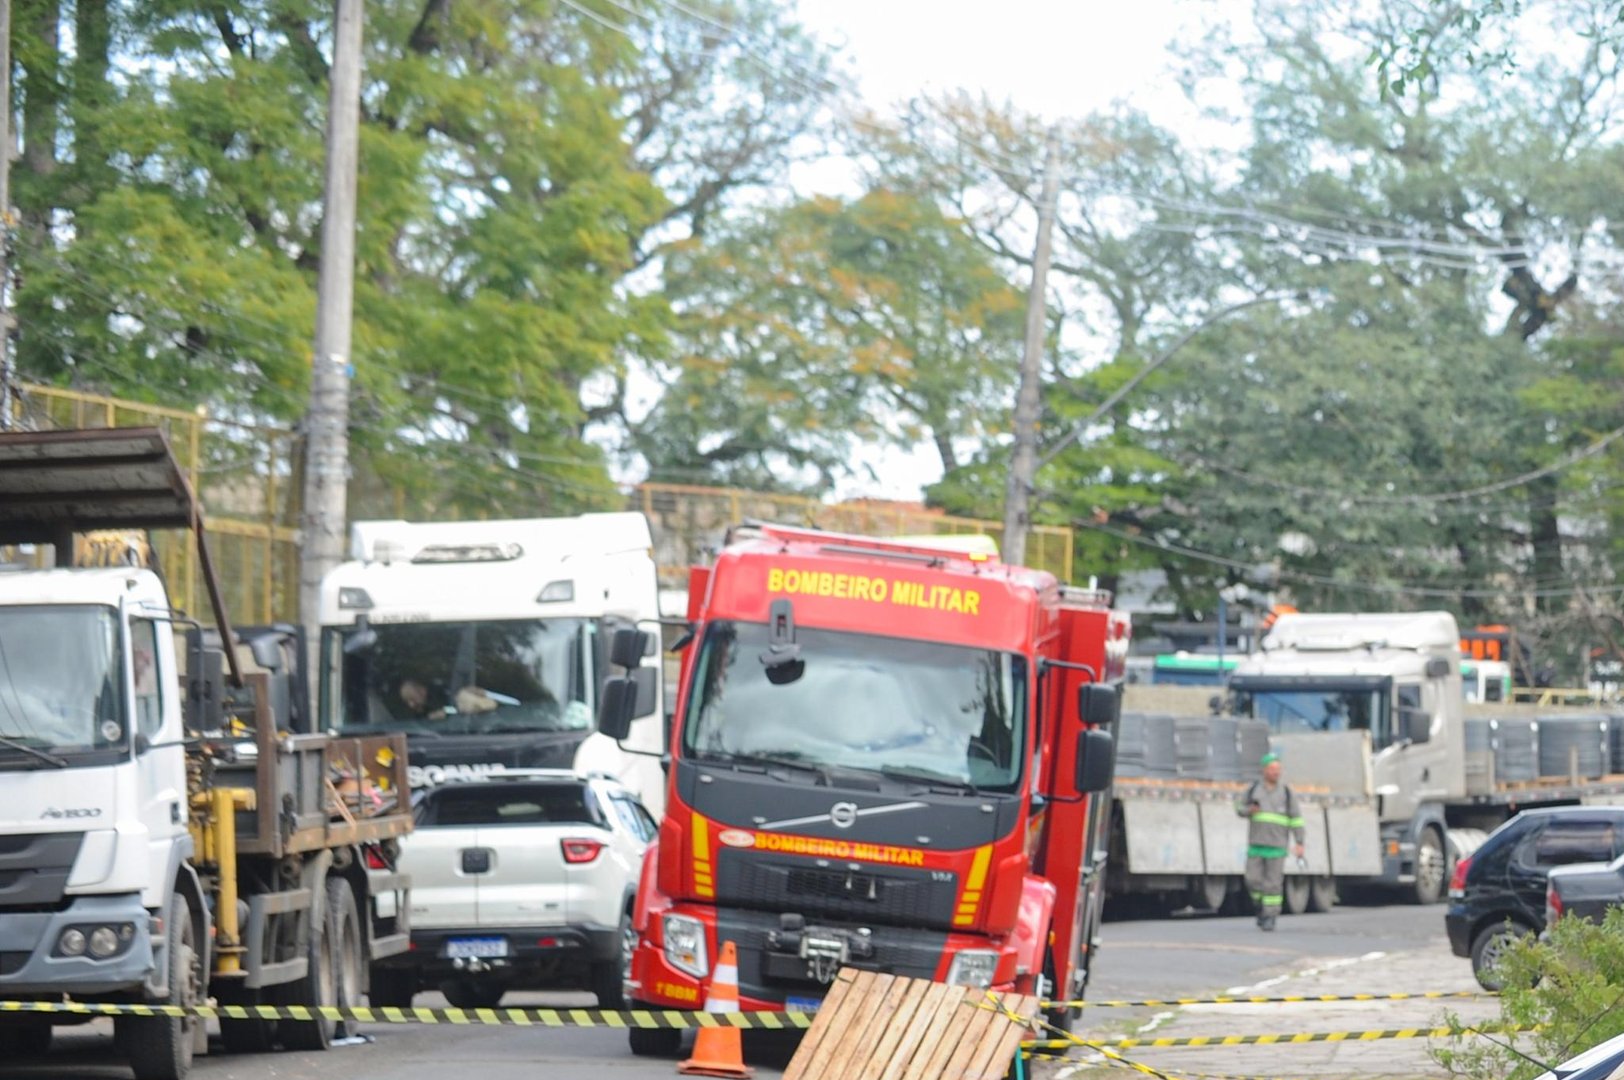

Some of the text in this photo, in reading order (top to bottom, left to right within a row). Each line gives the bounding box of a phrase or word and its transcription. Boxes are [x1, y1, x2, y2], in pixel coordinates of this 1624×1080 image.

[768, 568, 981, 615] BOMBEIRO MILITAR
[754, 833, 851, 858] BOMBEIRO
[853, 843, 924, 866] MILITAR
